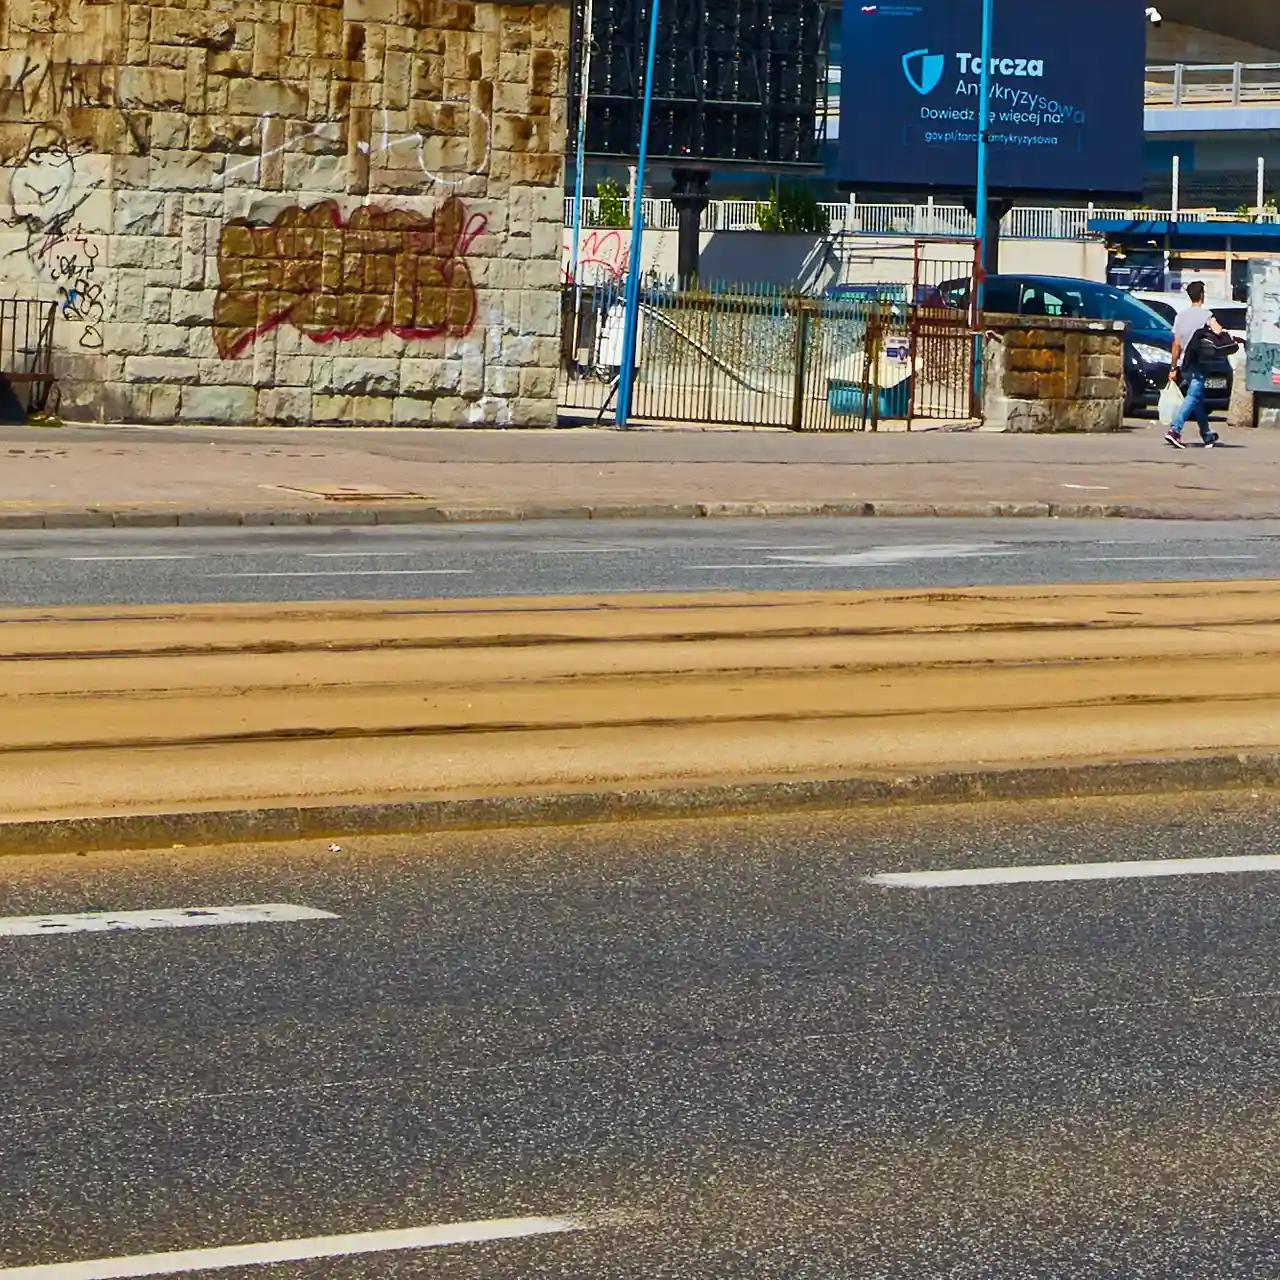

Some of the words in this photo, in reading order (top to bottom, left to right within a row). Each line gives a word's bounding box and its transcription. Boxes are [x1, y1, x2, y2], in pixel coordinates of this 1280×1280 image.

[956, 52, 1044, 77] Tarcza
[920, 107, 974, 120] Dowiedz
[999, 110, 1041, 126] więcej
